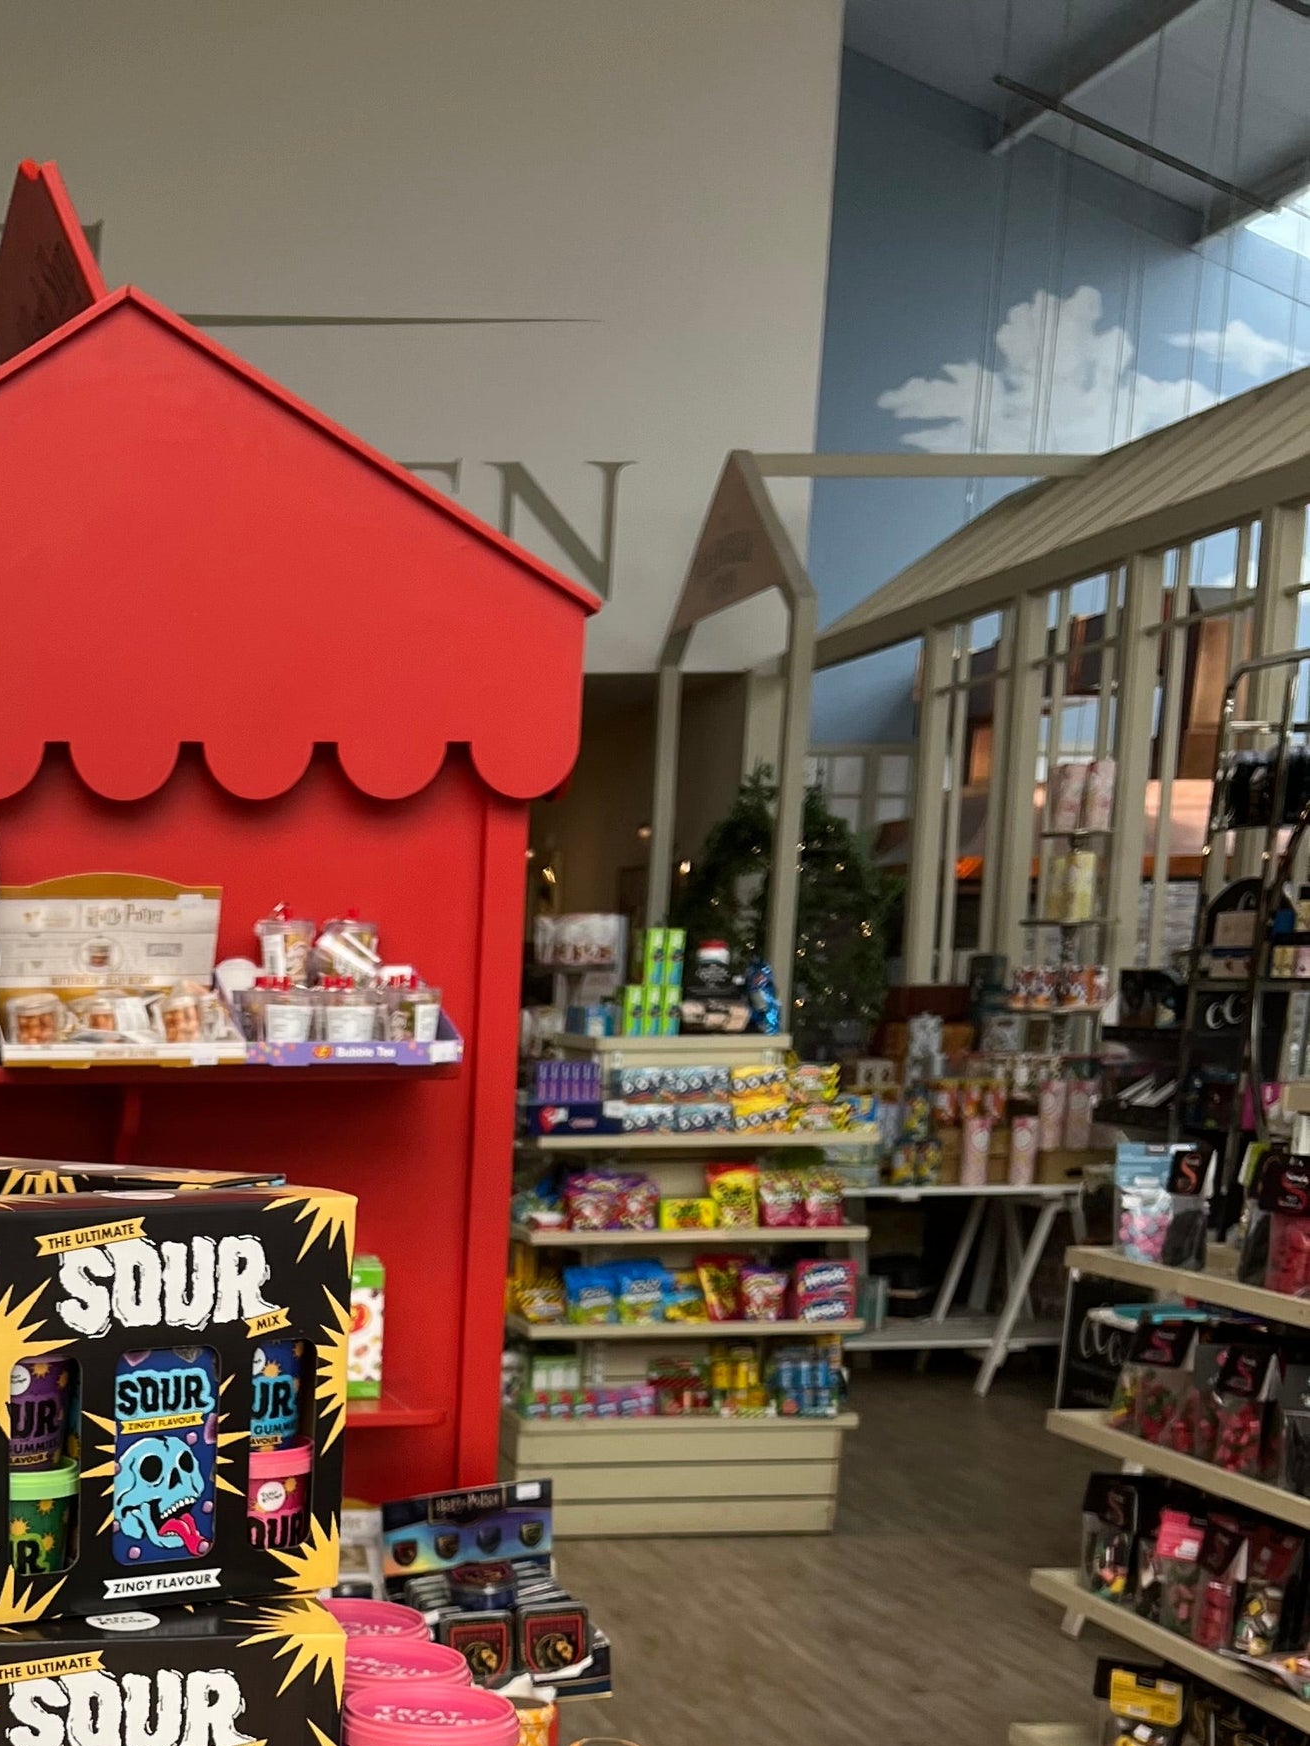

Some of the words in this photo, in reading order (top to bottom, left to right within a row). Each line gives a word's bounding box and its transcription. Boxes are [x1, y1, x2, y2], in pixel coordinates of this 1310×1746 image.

[47, 1234, 73, 1250] THE
[75, 1223, 135, 1244] ULTIMATE
[56, 1235, 281, 1340] SOUR
[255, 1314, 280, 1329] MIX
[117, 1375, 208, 1416] SOUR
[127, 1419, 155, 1431] ZINGY
[158, 1414, 198, 1428] FLAVOUR
[248, 1511, 303, 1550] OUR
[113, 1581, 153, 1595] ZINGY
[156, 1574, 211, 1590] FLAVOUR
[26, 1656, 92, 1676] ULTIMATE
[374, 1705, 464, 1718] TREAT
